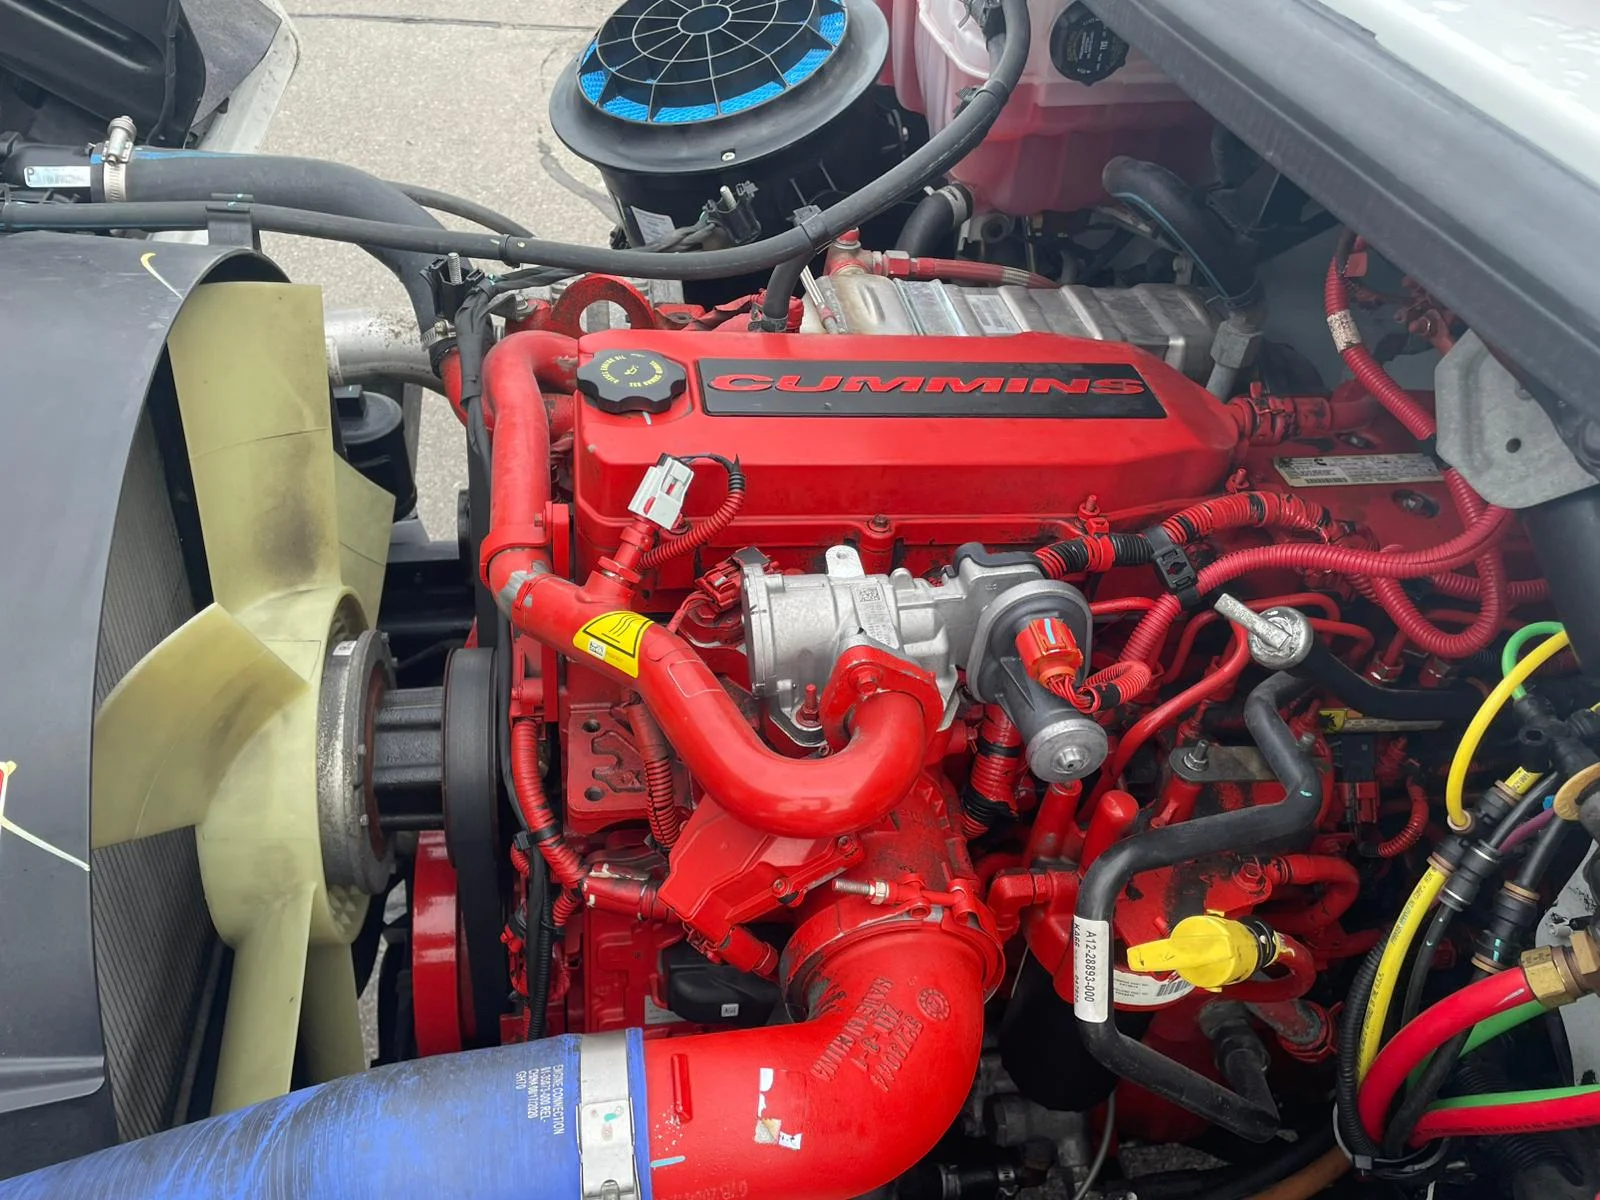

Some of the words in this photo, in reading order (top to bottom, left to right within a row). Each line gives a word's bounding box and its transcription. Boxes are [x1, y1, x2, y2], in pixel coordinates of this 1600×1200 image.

[708, 373, 1145, 395] CUMMINS
[1084, 930, 1097, 1003] A12-28893-000
[553, 1088, 565, 1134] CONNECTION
